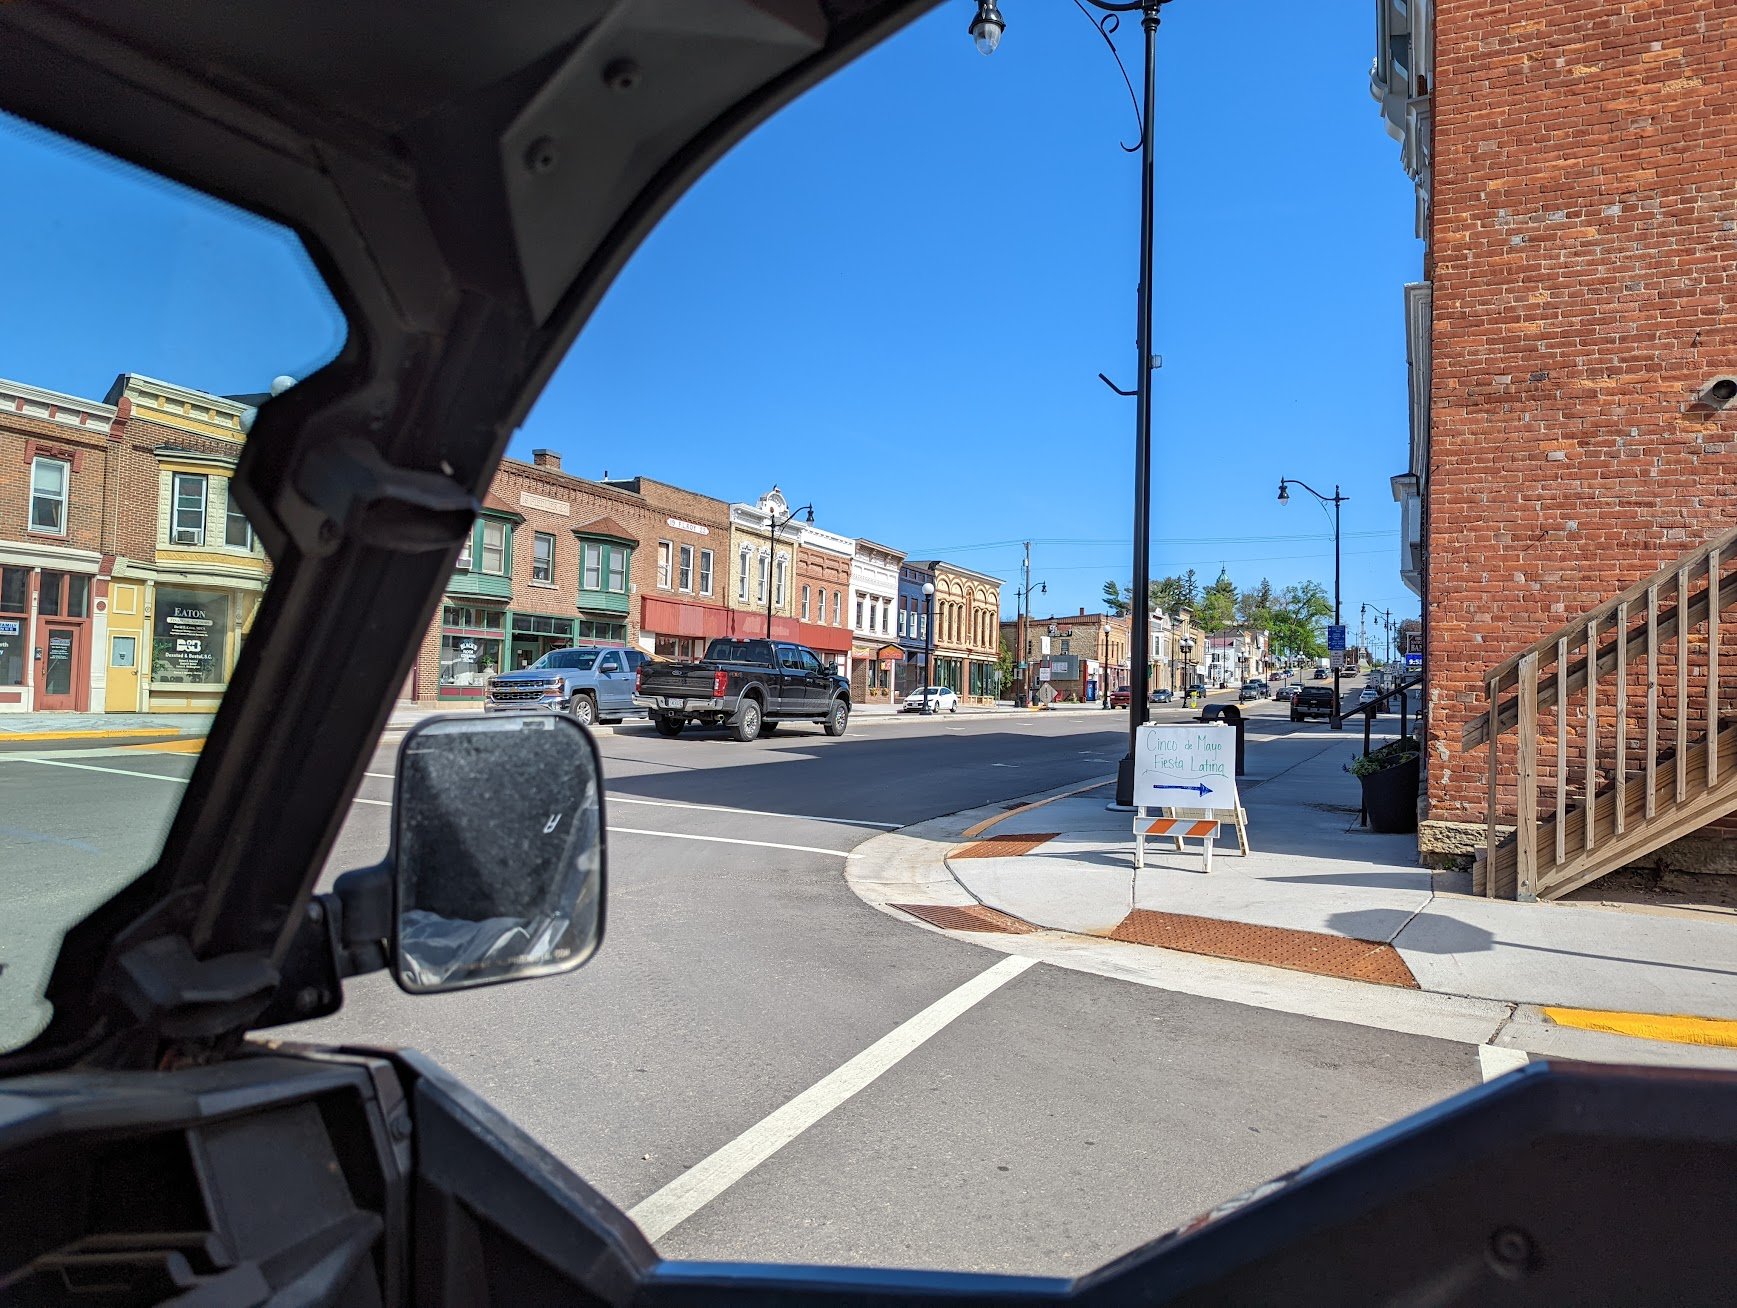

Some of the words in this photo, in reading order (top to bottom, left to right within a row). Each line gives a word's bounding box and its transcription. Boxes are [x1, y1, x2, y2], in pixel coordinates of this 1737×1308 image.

[174, 607, 206, 618] EATON
[1146, 730, 1178, 752] Cinco
[1184, 739, 1193, 750] de
[1197, 735, 1222, 761] Mayo
[1154, 754, 1184, 771] Fiesta
[1191, 756, 1225, 773] Latina
